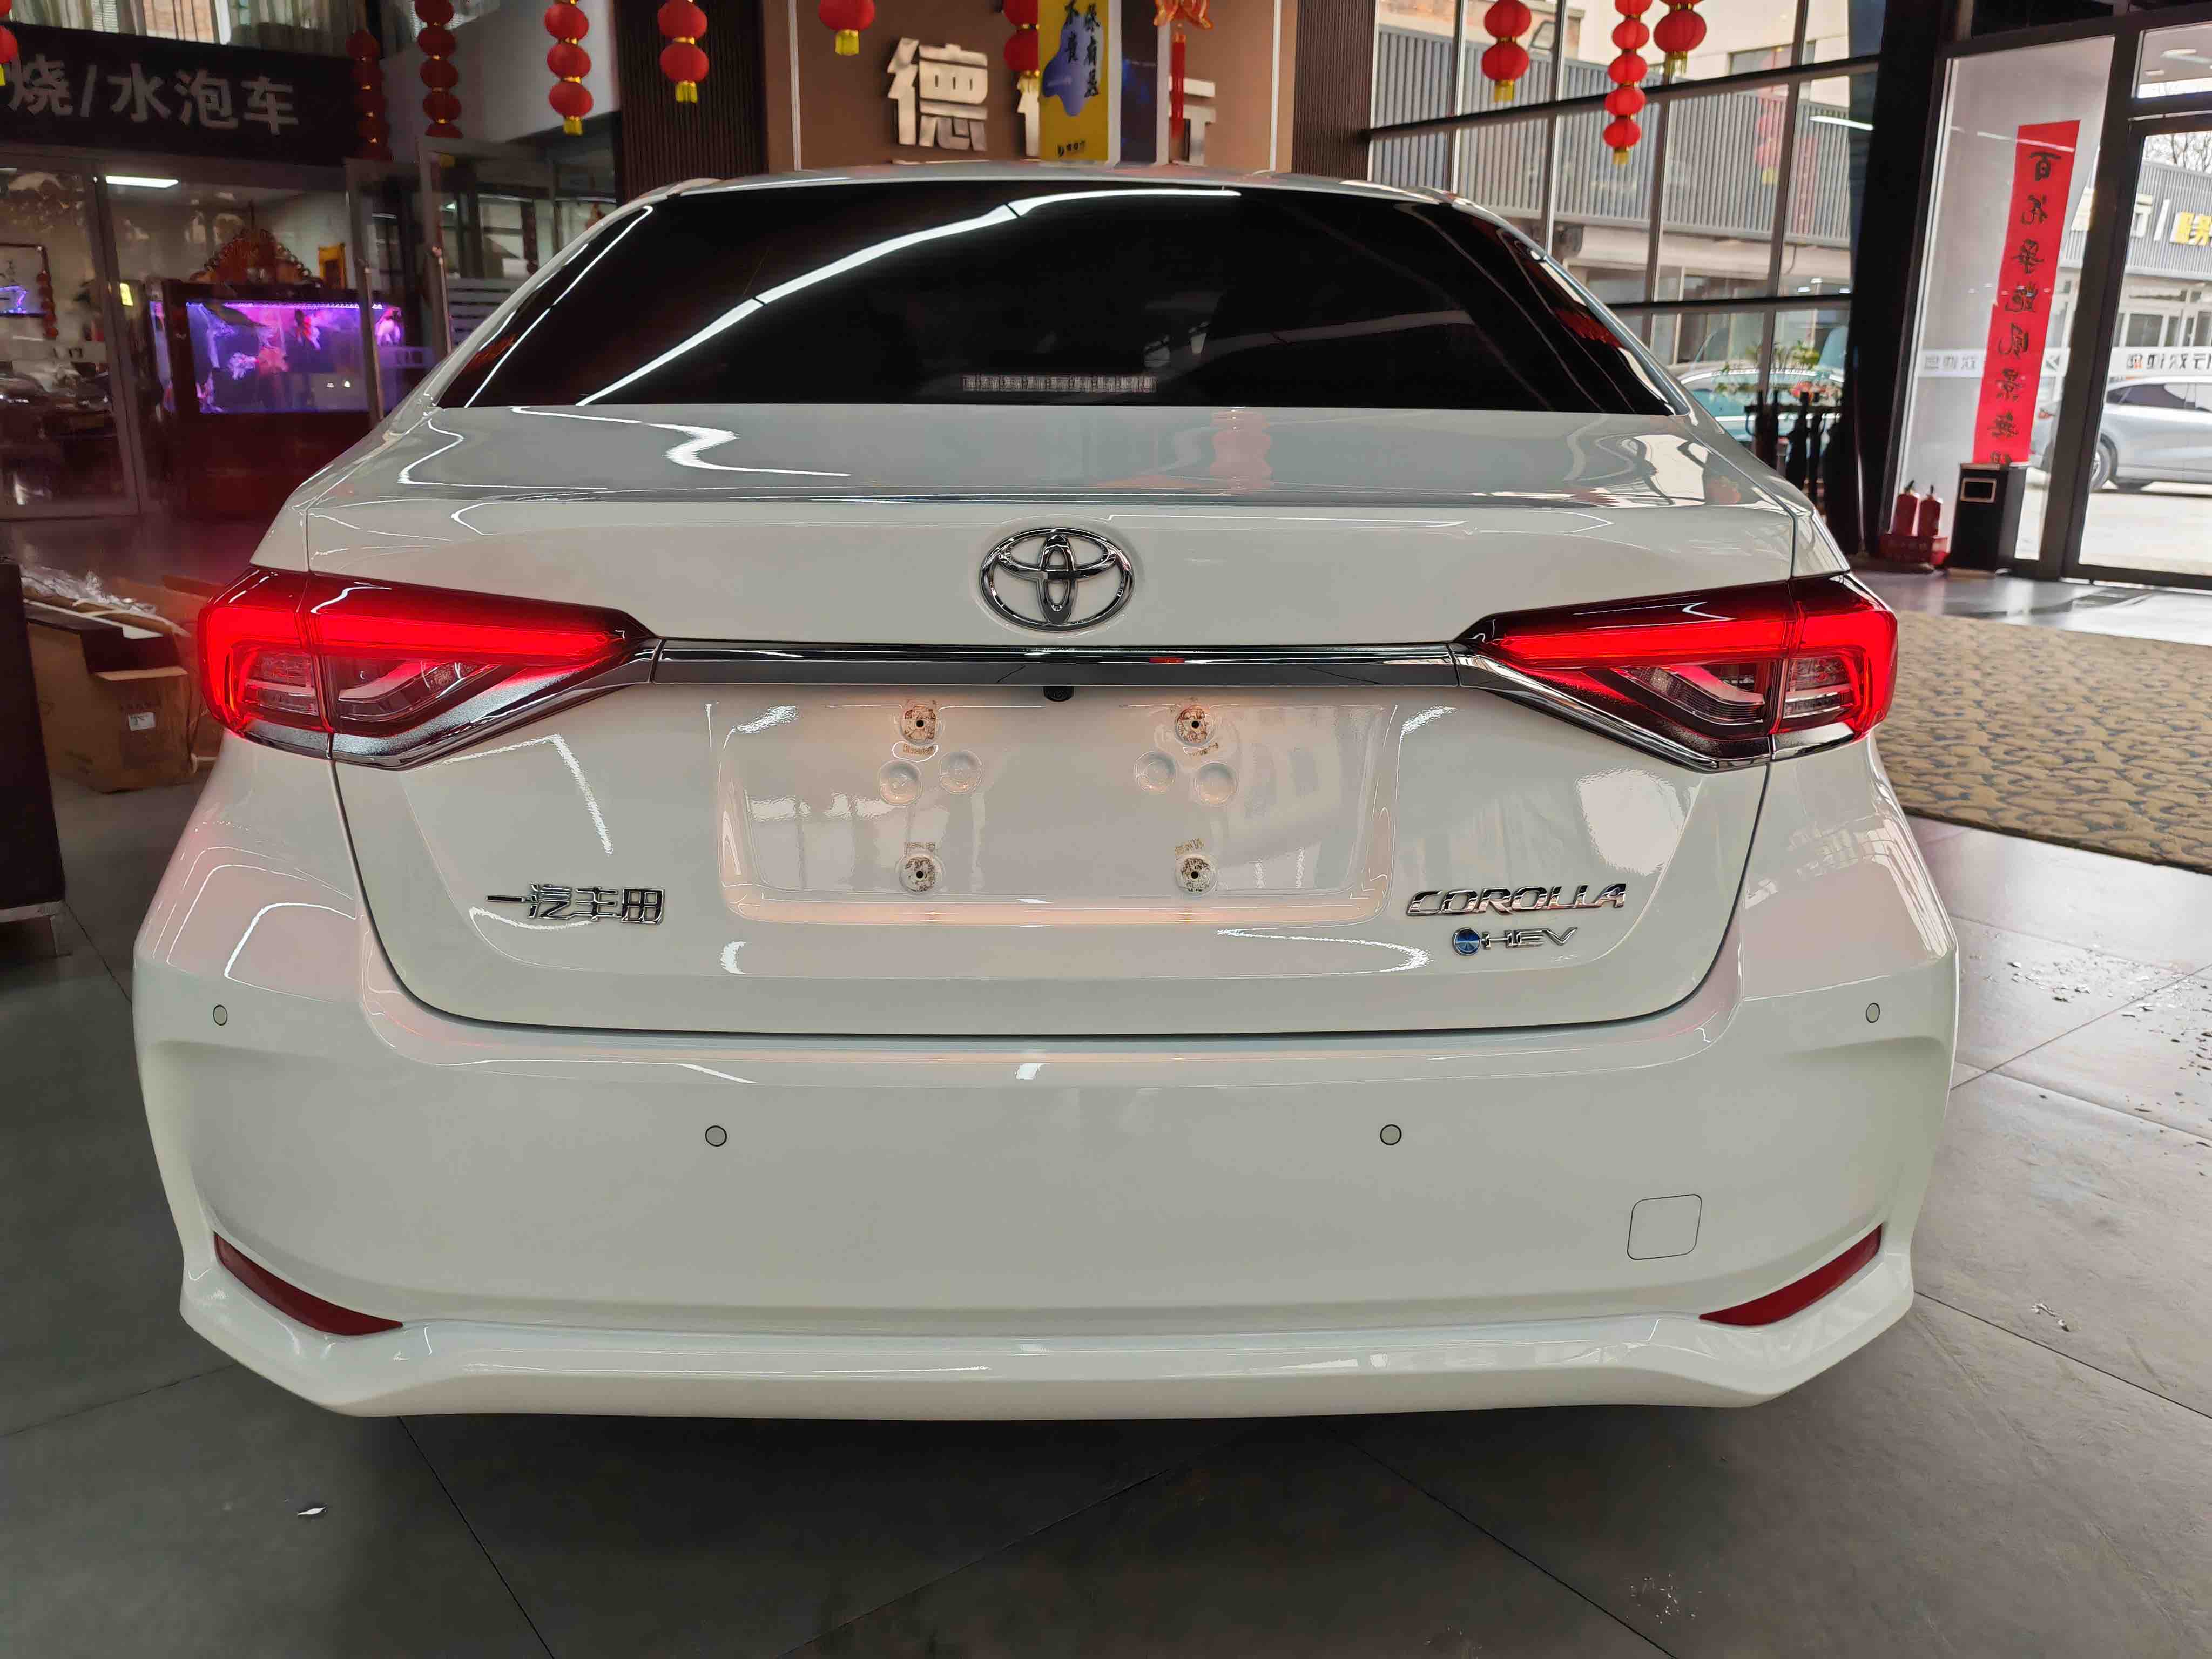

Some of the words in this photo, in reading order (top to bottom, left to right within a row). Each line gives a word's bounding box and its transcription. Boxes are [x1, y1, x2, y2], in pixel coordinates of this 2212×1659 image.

[4, 54, 299, 137] 烧/水泡车
[485, 882, 665, 925] 一汽丰田
[1406, 883, 1627, 916] COROLLA
[1481, 927, 1579, 950] HEV
